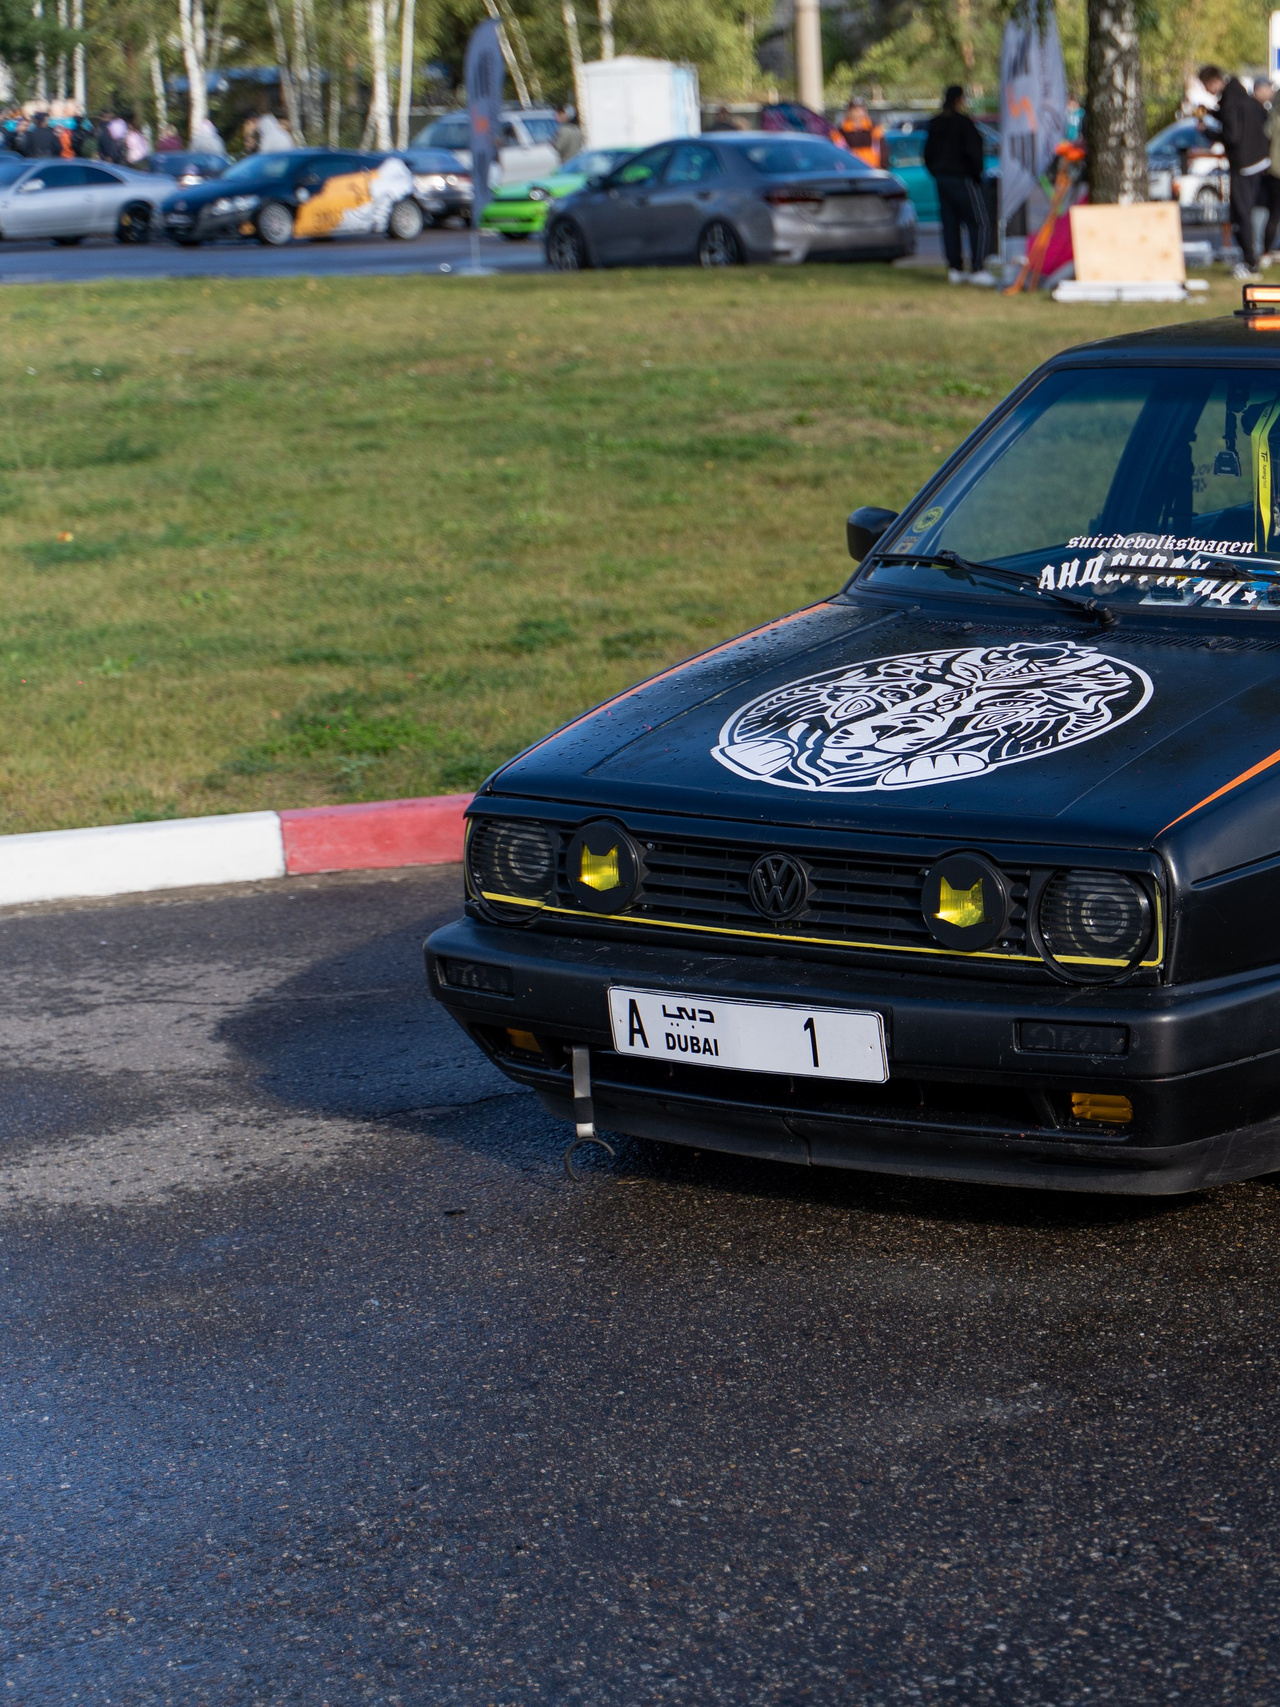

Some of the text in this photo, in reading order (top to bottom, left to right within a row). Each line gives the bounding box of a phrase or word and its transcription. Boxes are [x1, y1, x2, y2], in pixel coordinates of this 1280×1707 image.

[1066, 533, 1255, 554] suicidevolkswagen
[662, 1004, 715, 1029] دبي
[628, 998, 820, 1068] A 1
[665, 1032, 720, 1057] DUBAI
